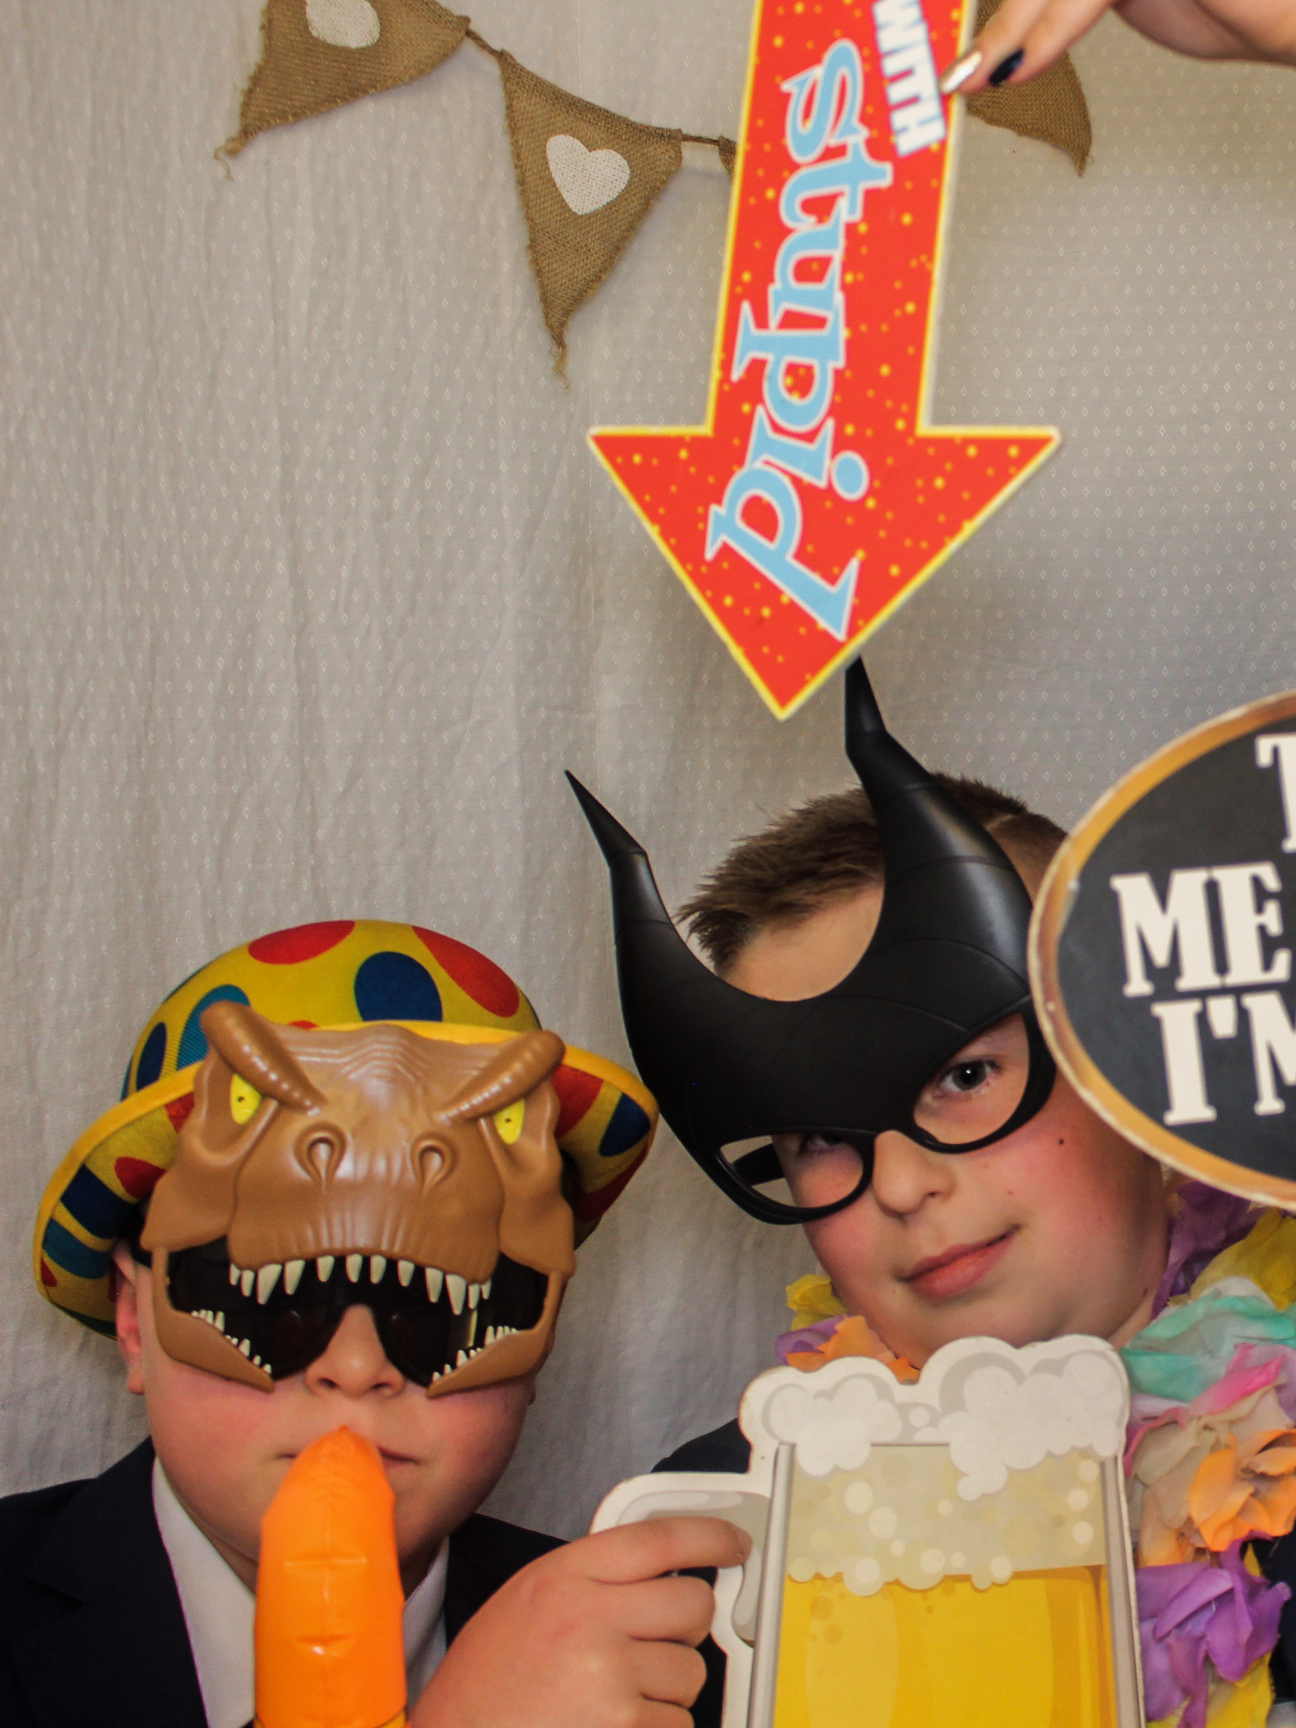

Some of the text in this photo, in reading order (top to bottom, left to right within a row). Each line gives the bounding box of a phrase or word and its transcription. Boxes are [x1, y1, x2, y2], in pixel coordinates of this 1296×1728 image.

[872, 0, 946, 156] WITH
[704, 40, 893, 642] stupid
[1111, 862, 1291, 996] ME
